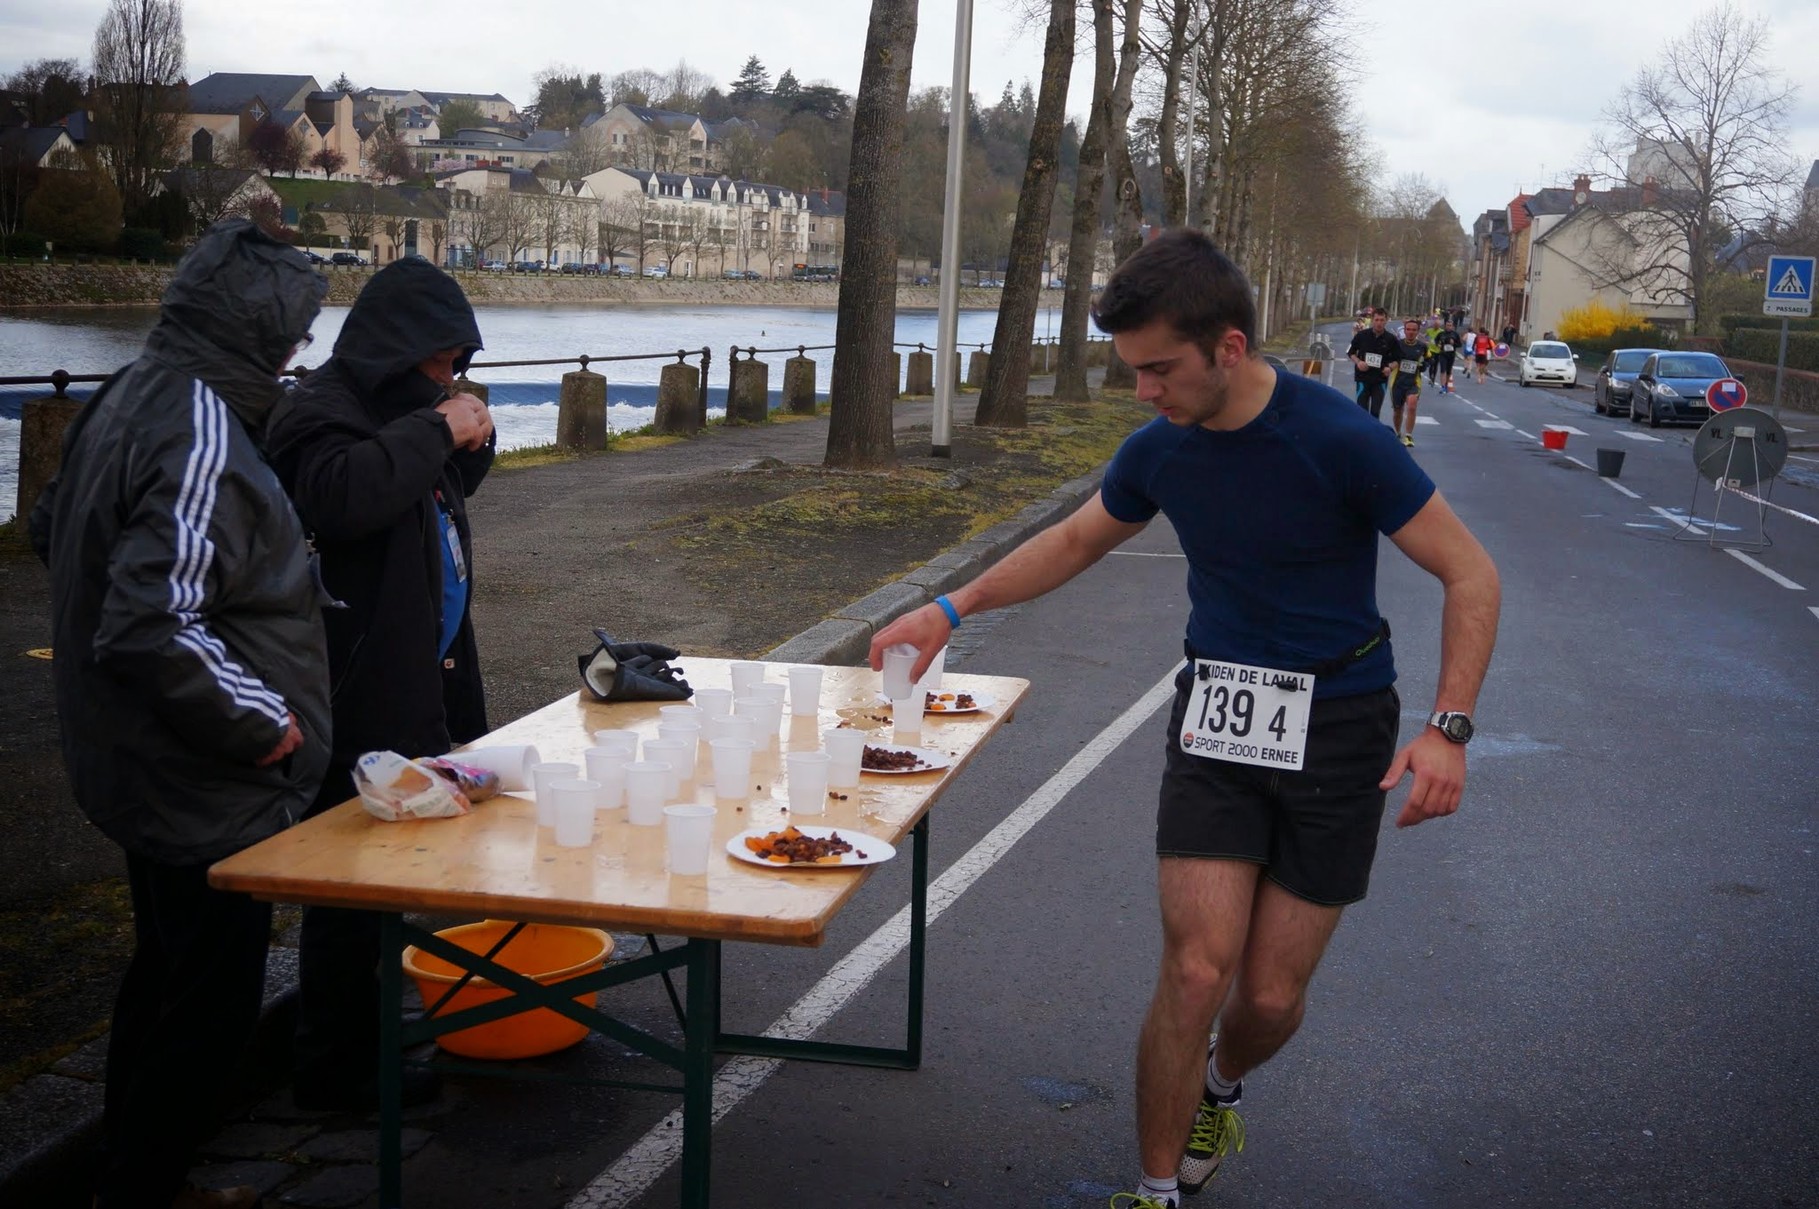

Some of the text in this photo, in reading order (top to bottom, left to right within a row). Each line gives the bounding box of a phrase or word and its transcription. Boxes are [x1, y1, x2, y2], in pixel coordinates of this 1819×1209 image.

[1198, 663, 1235, 682] KIDEN
[1239, 669, 1258, 684] DE
[1198, 685, 1255, 737] 139
[1268, 705, 1287, 742] 4
[1194, 736, 1226, 754] SPORT
[1228, 742, 1258, 759] 2000
[1261, 747, 1299, 764] ERNEE
